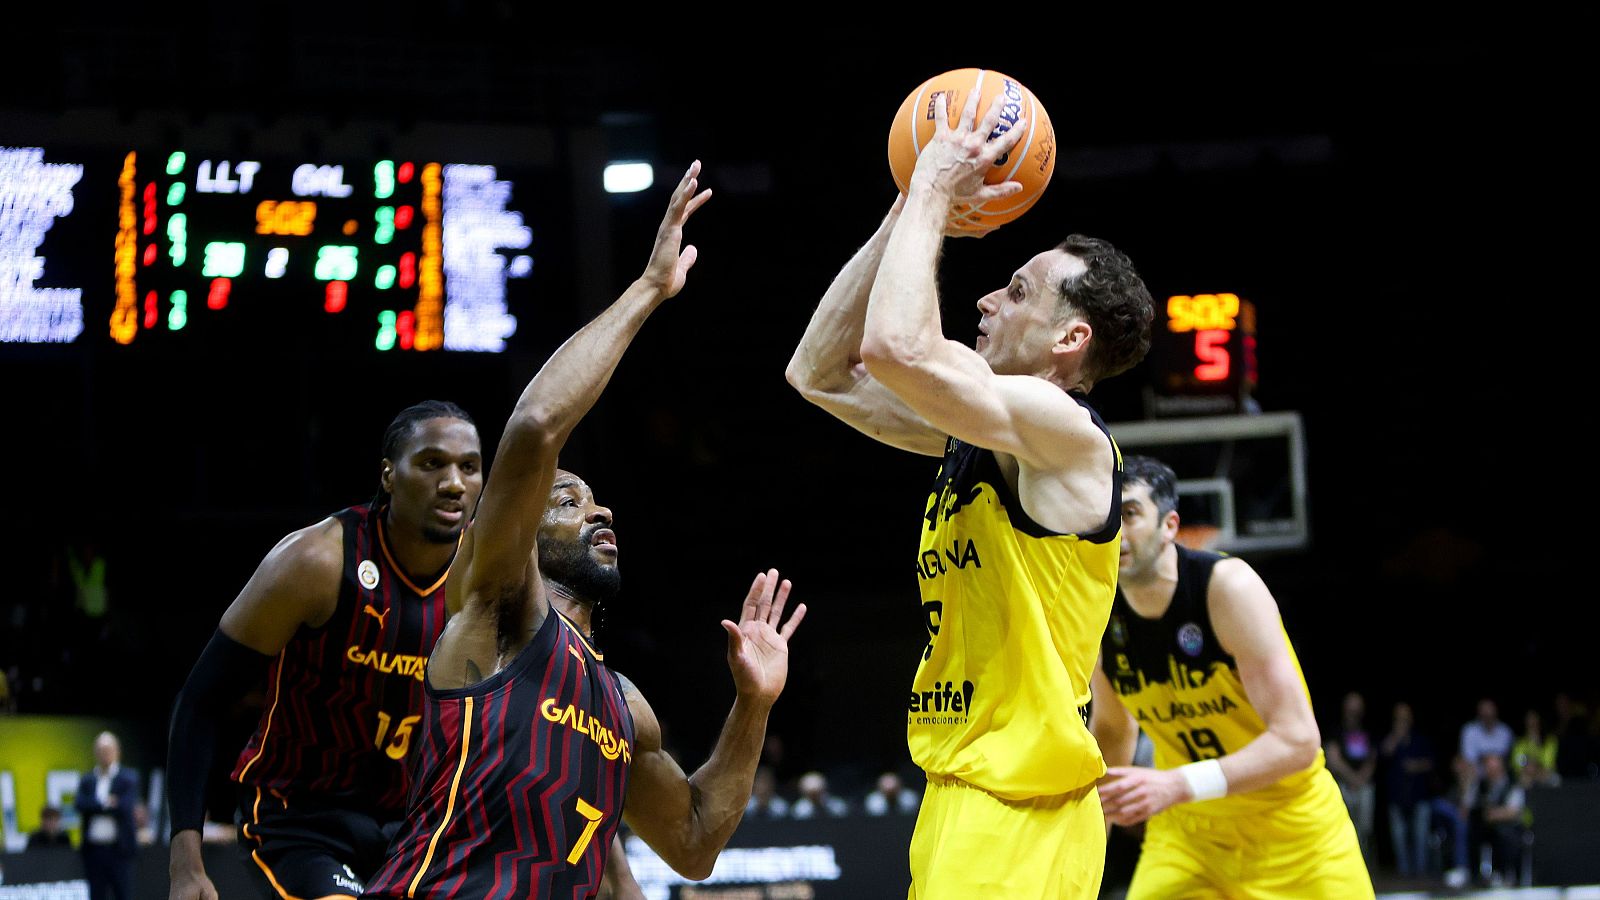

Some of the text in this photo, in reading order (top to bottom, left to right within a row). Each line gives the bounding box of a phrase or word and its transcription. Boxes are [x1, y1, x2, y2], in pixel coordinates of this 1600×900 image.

[196, 160, 261, 193] LLT
[1194, 329, 1231, 381] 5
[1151, 695, 1238, 723] LAGUNA
[374, 711, 422, 760] 15
[1177, 728, 1227, 762] 19
[567, 797, 604, 865] 7
